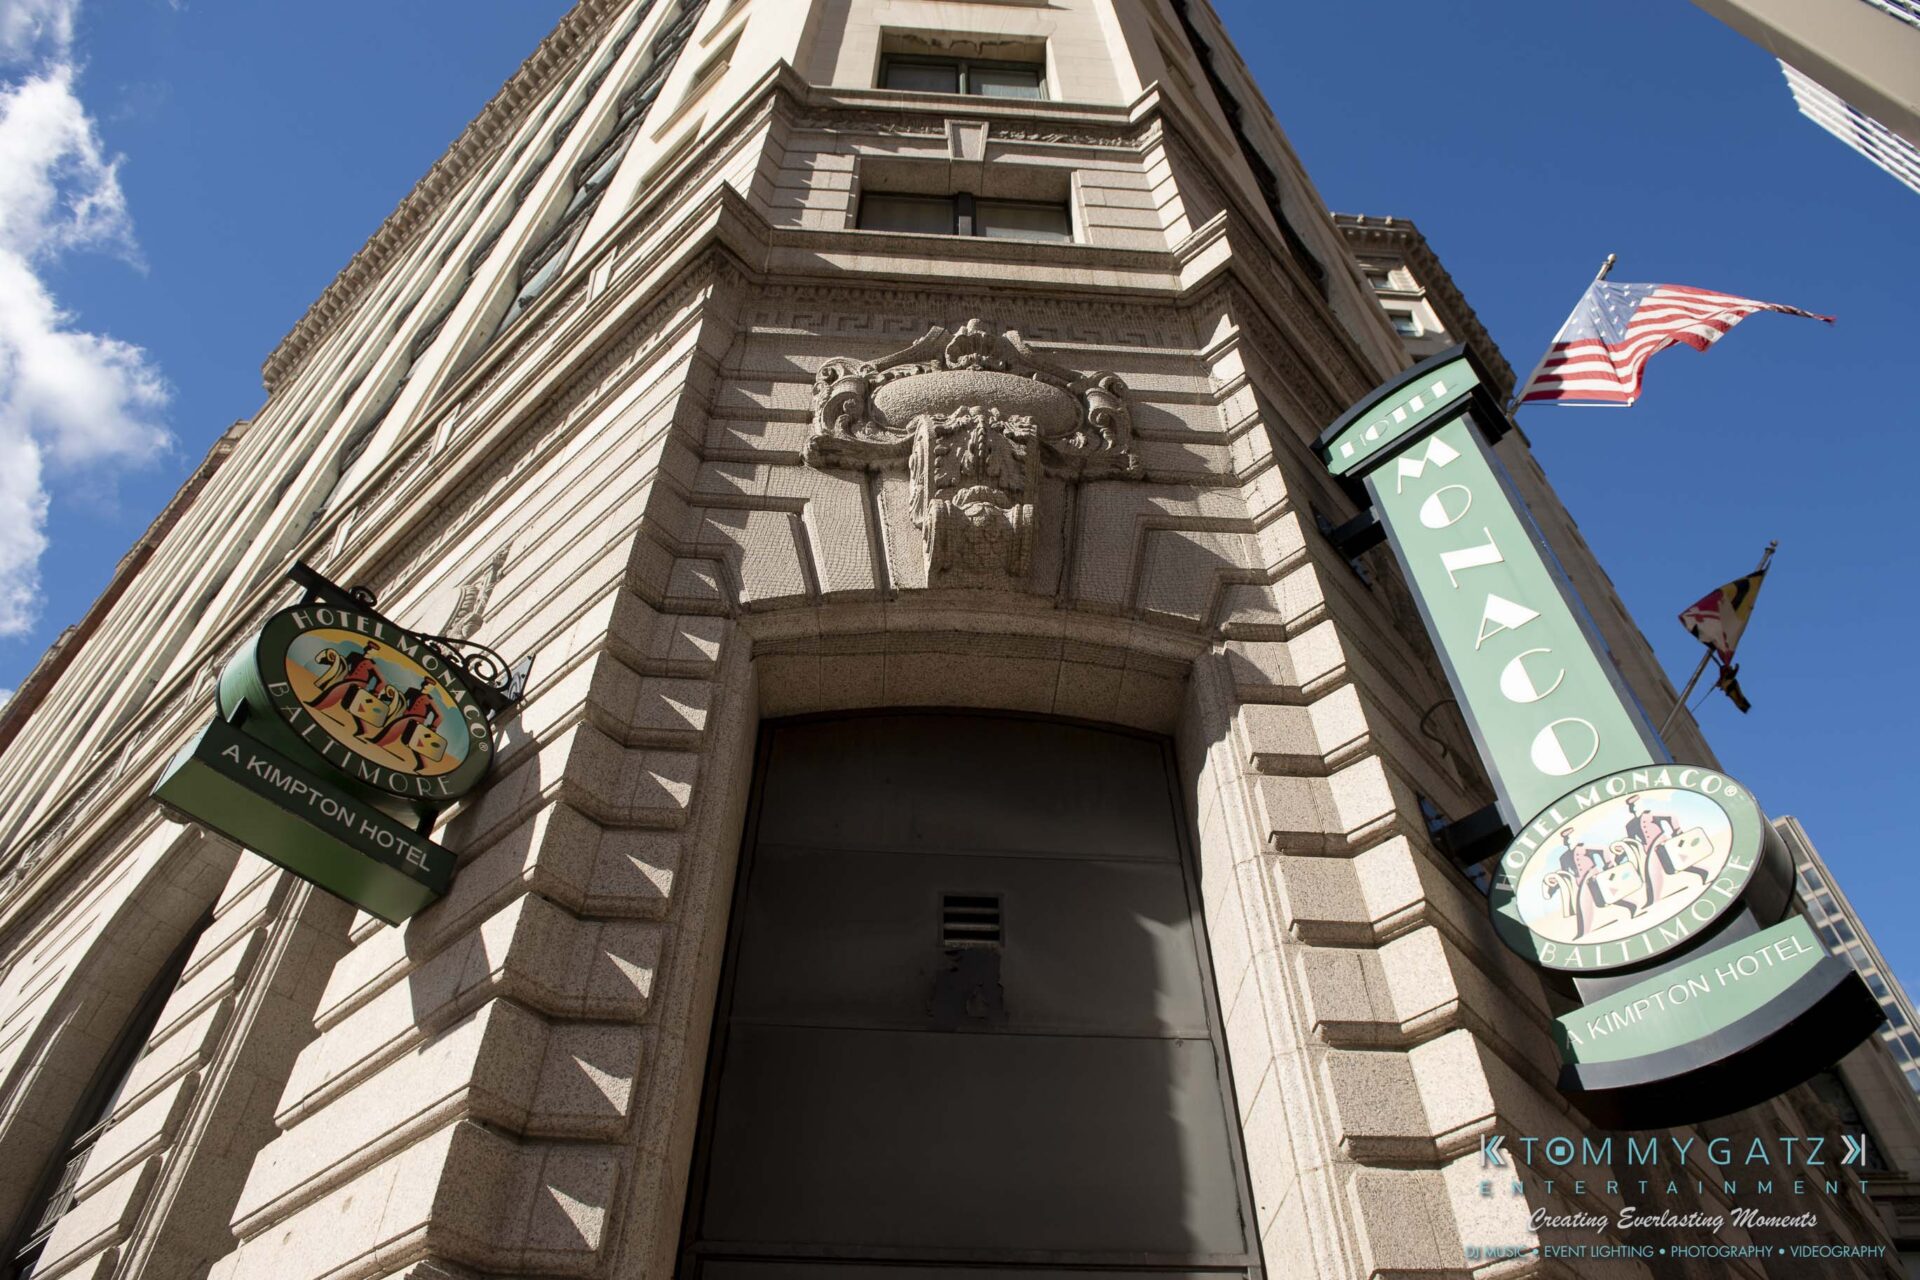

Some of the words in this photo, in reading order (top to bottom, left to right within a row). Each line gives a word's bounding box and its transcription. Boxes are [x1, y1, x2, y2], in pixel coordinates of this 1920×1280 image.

[290, 608, 385, 640] HOTEL
[1397, 435, 1600, 776] MONACO
[268, 681, 455, 796] BALTIMORE
[221, 743, 241, 764] A
[245, 760, 356, 828] KIMPTON
[358, 821, 430, 872] HOTEL
[1495, 808, 1569, 892] HOTEL
[1538, 854, 1755, 967] BALTIMORE
[1565, 1029, 1585, 1049] A
[1586, 974, 1712, 1040] KIMPTON
[1714, 934, 1814, 987] HOTEL
